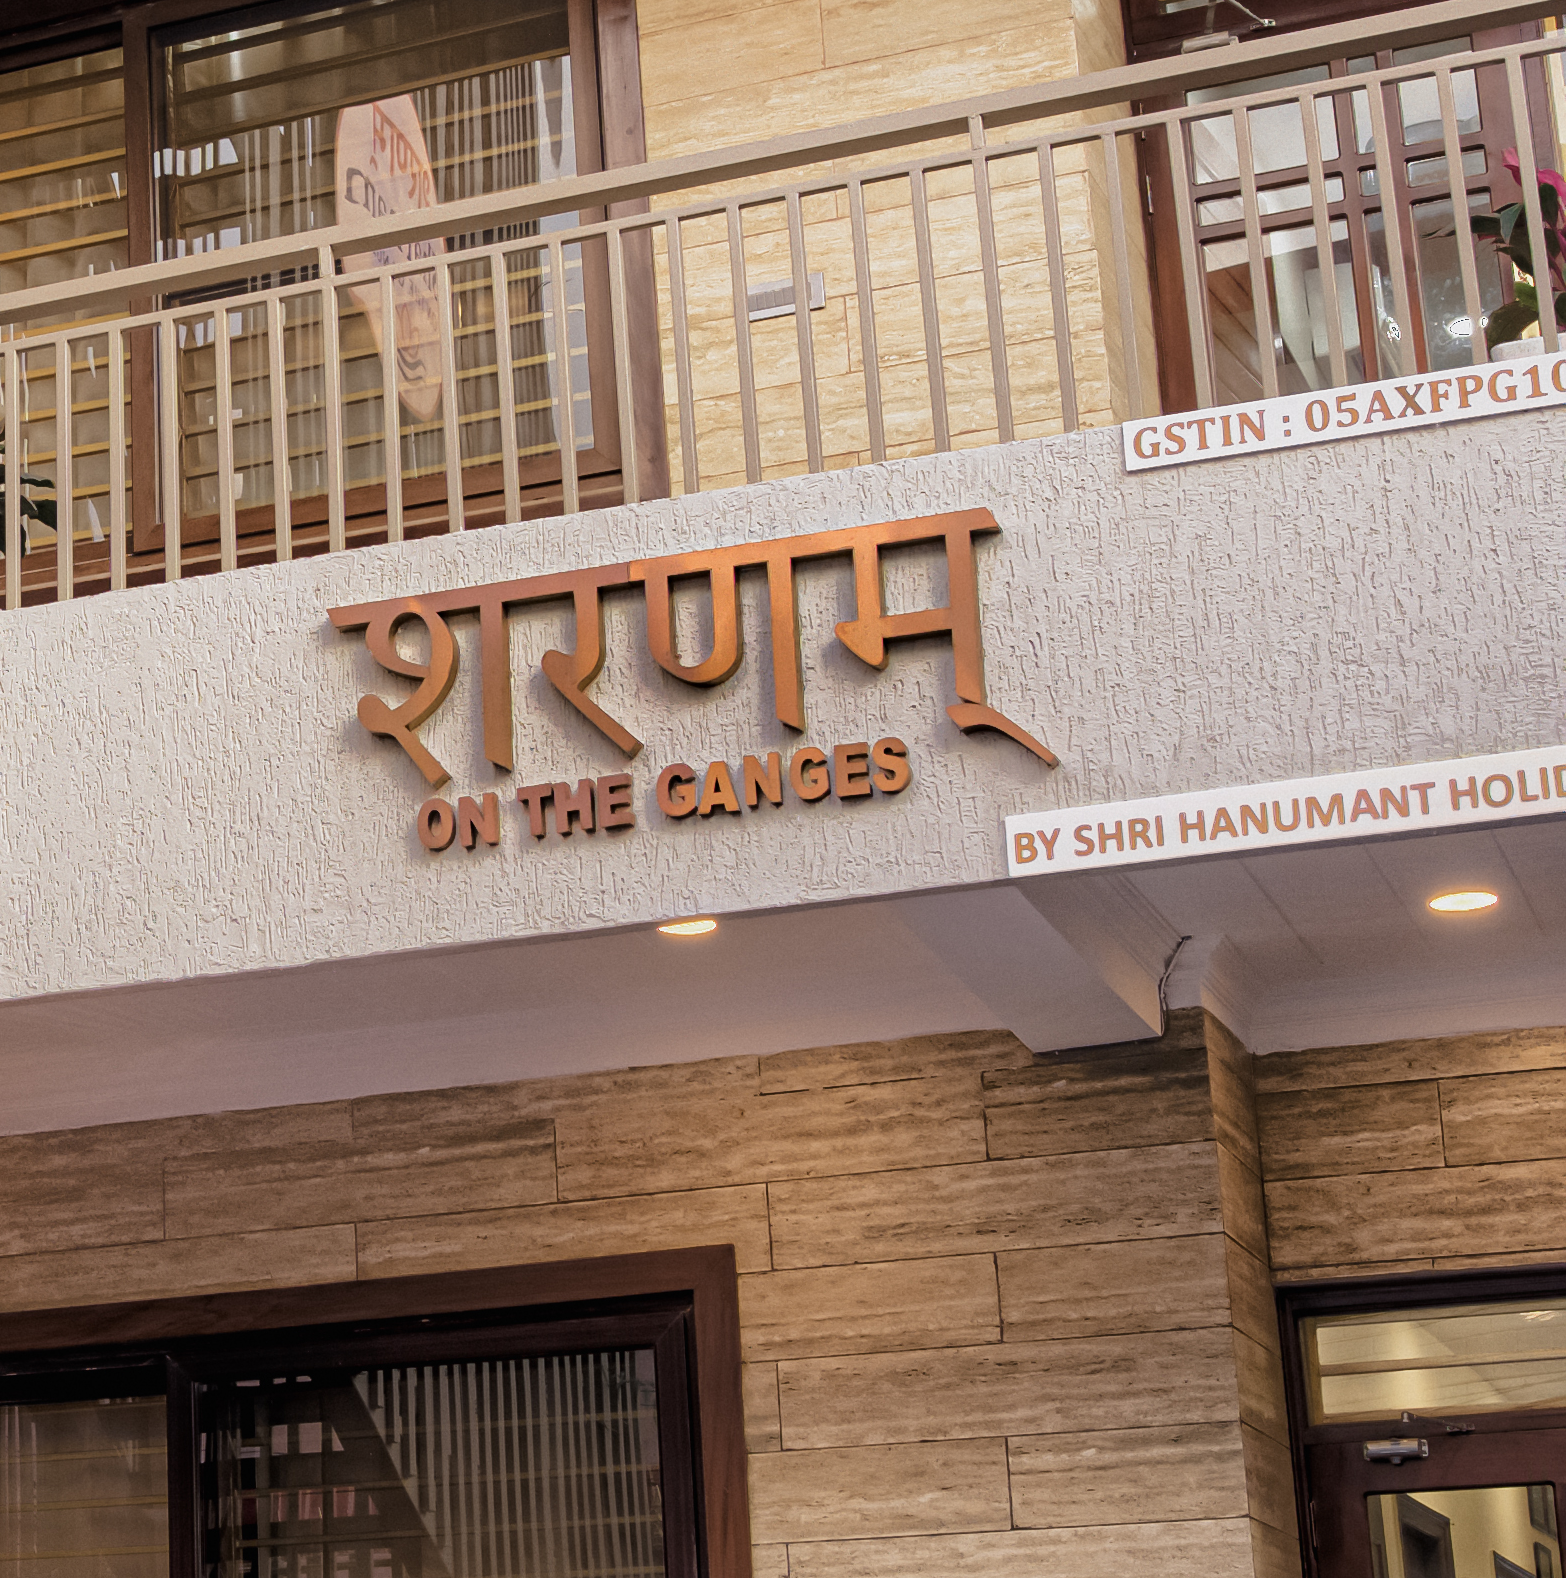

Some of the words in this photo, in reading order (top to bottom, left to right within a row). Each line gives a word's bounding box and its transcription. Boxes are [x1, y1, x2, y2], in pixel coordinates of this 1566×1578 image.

[1132, 410, 1267, 460] GSTIN
[326, 507, 1059, 791] शरणम्
[417, 792, 501, 851] ON
[517, 773, 634, 840] THE
[656, 736, 912, 819] GANGES
[1014, 827, 1061, 864] BY
[1074, 815, 1165, 857] SHRI
[1179, 781, 1436, 843] HANUMANT
